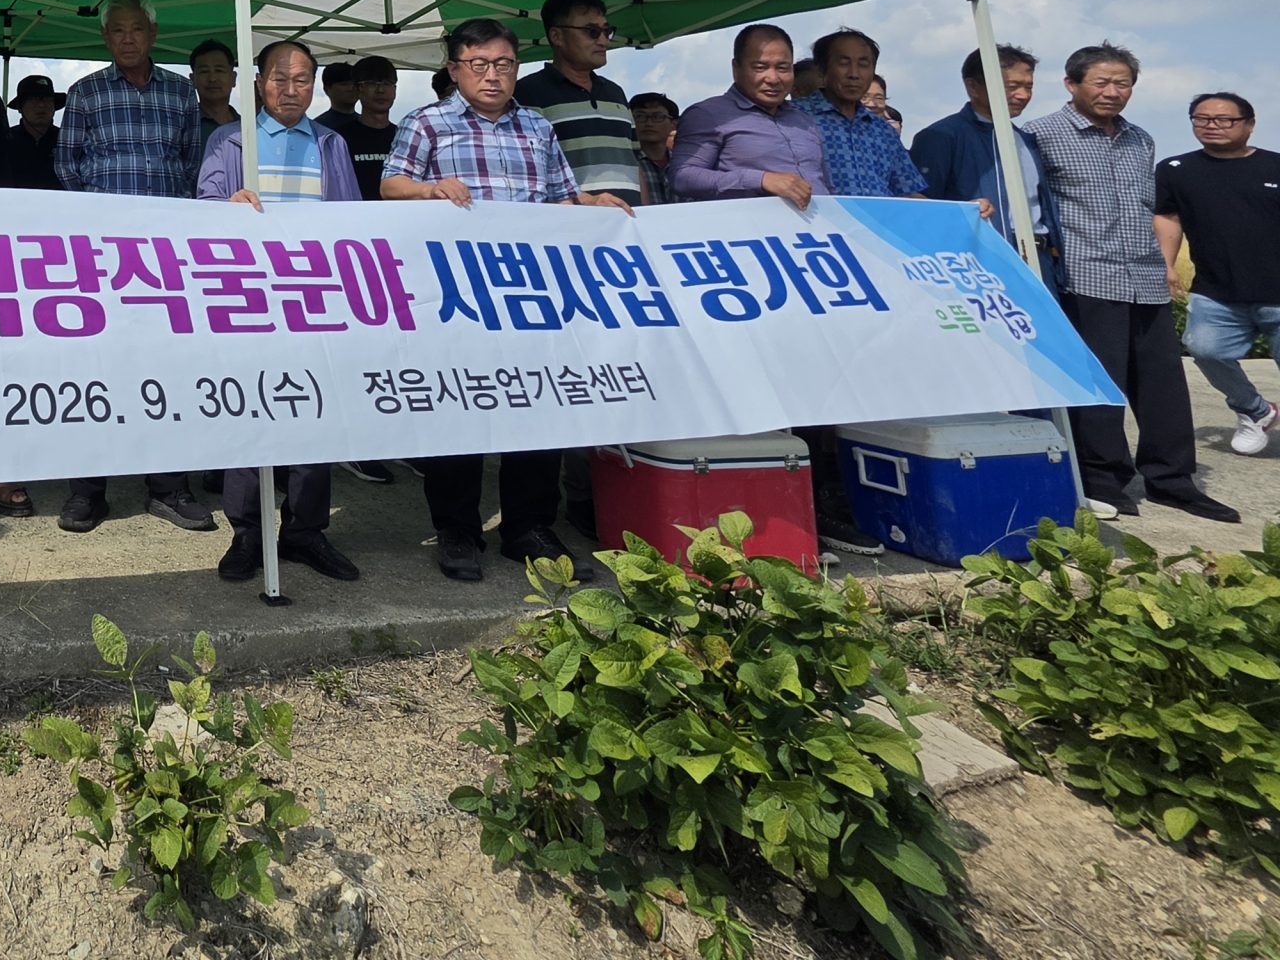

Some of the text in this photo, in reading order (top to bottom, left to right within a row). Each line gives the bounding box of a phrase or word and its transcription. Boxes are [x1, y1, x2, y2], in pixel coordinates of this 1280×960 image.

[425, 240, 680, 331] 시범사업
[661, 232, 890, 322] 평가회
[902, 259, 950, 284] 시민
[935, 294, 1032, 340] 으뜸 정읍
[2, 361, 657, 426] 2026. 9. 30.(수) 정읍시농업기술센터
